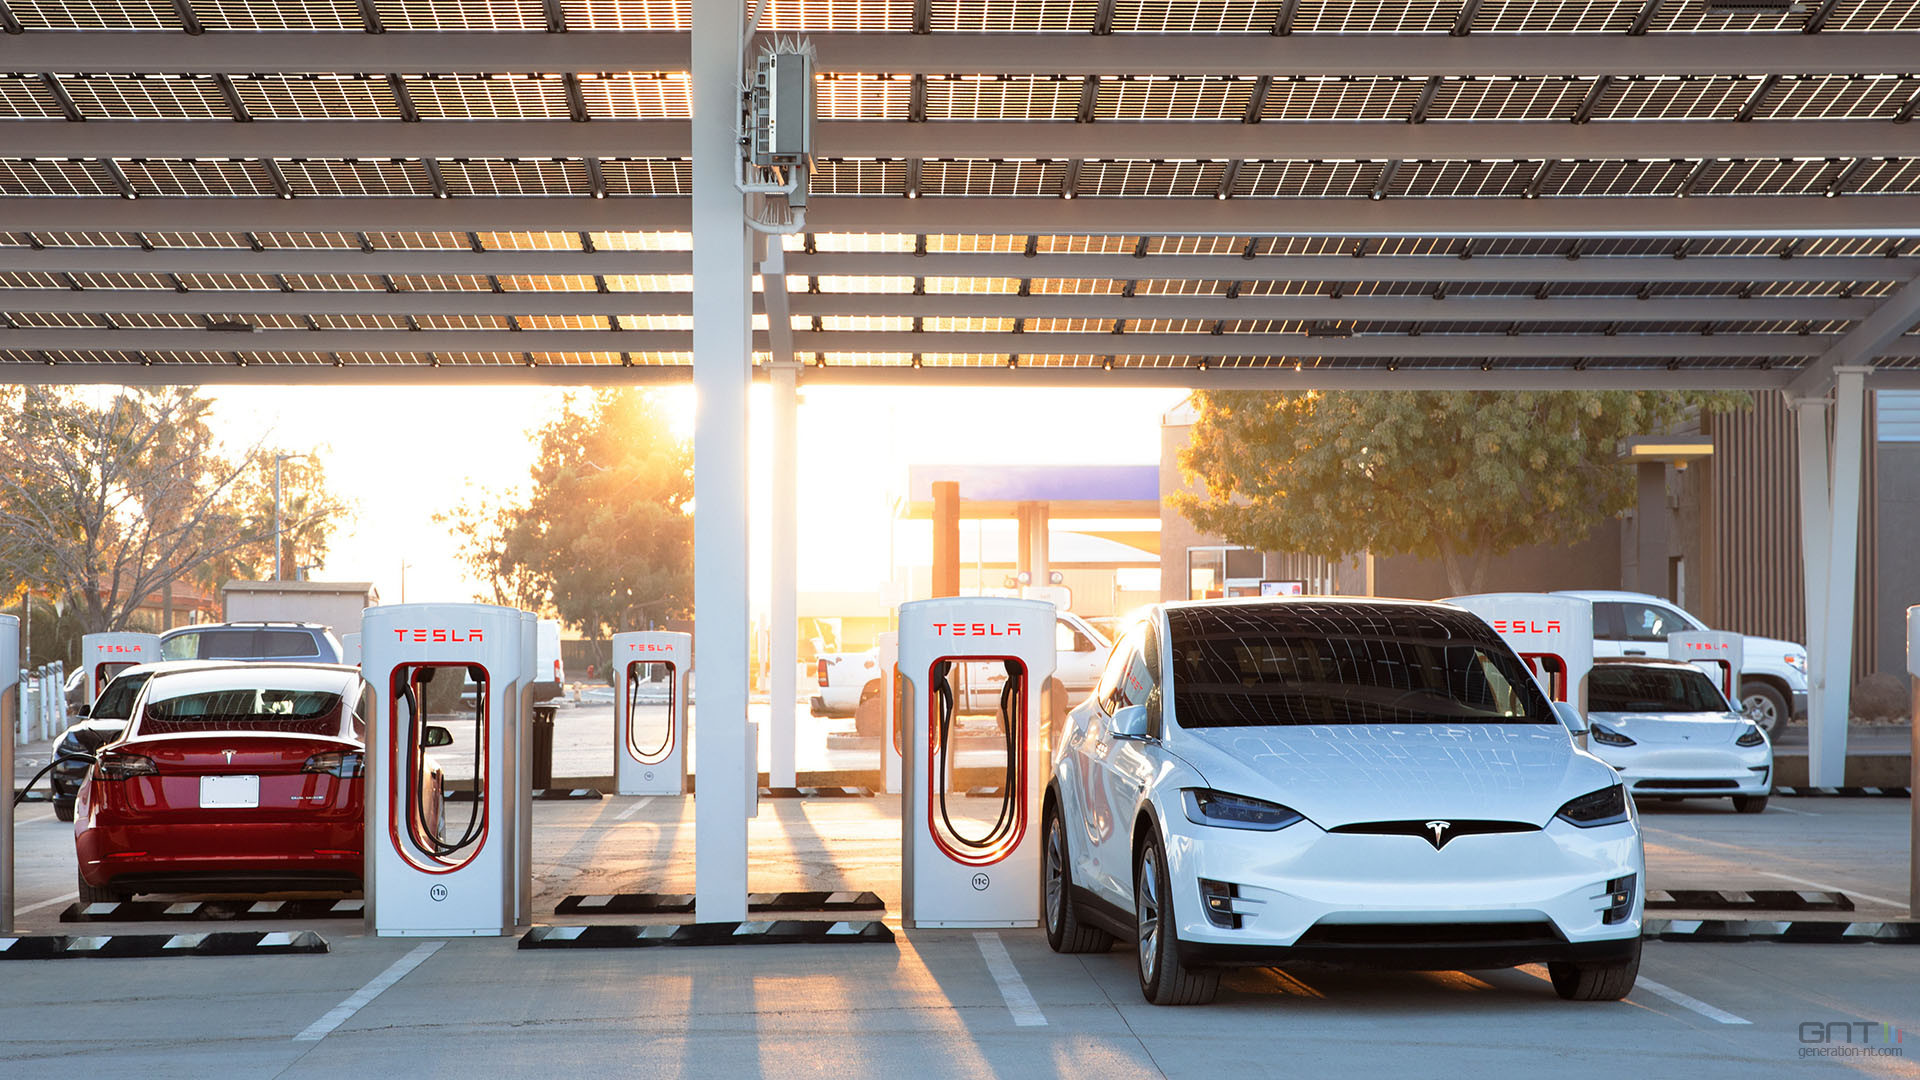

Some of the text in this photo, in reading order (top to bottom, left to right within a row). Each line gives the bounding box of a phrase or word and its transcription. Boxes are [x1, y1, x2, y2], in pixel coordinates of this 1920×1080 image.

[932, 623, 1022, 636] TESLA
[1493, 620, 1561, 633] ESLA
[393, 628, 484, 642] TESLA
[97, 645, 142, 653] TESLA
[629, 643, 673, 652] TESLA
[1686, 642, 1729, 650] TESLA
